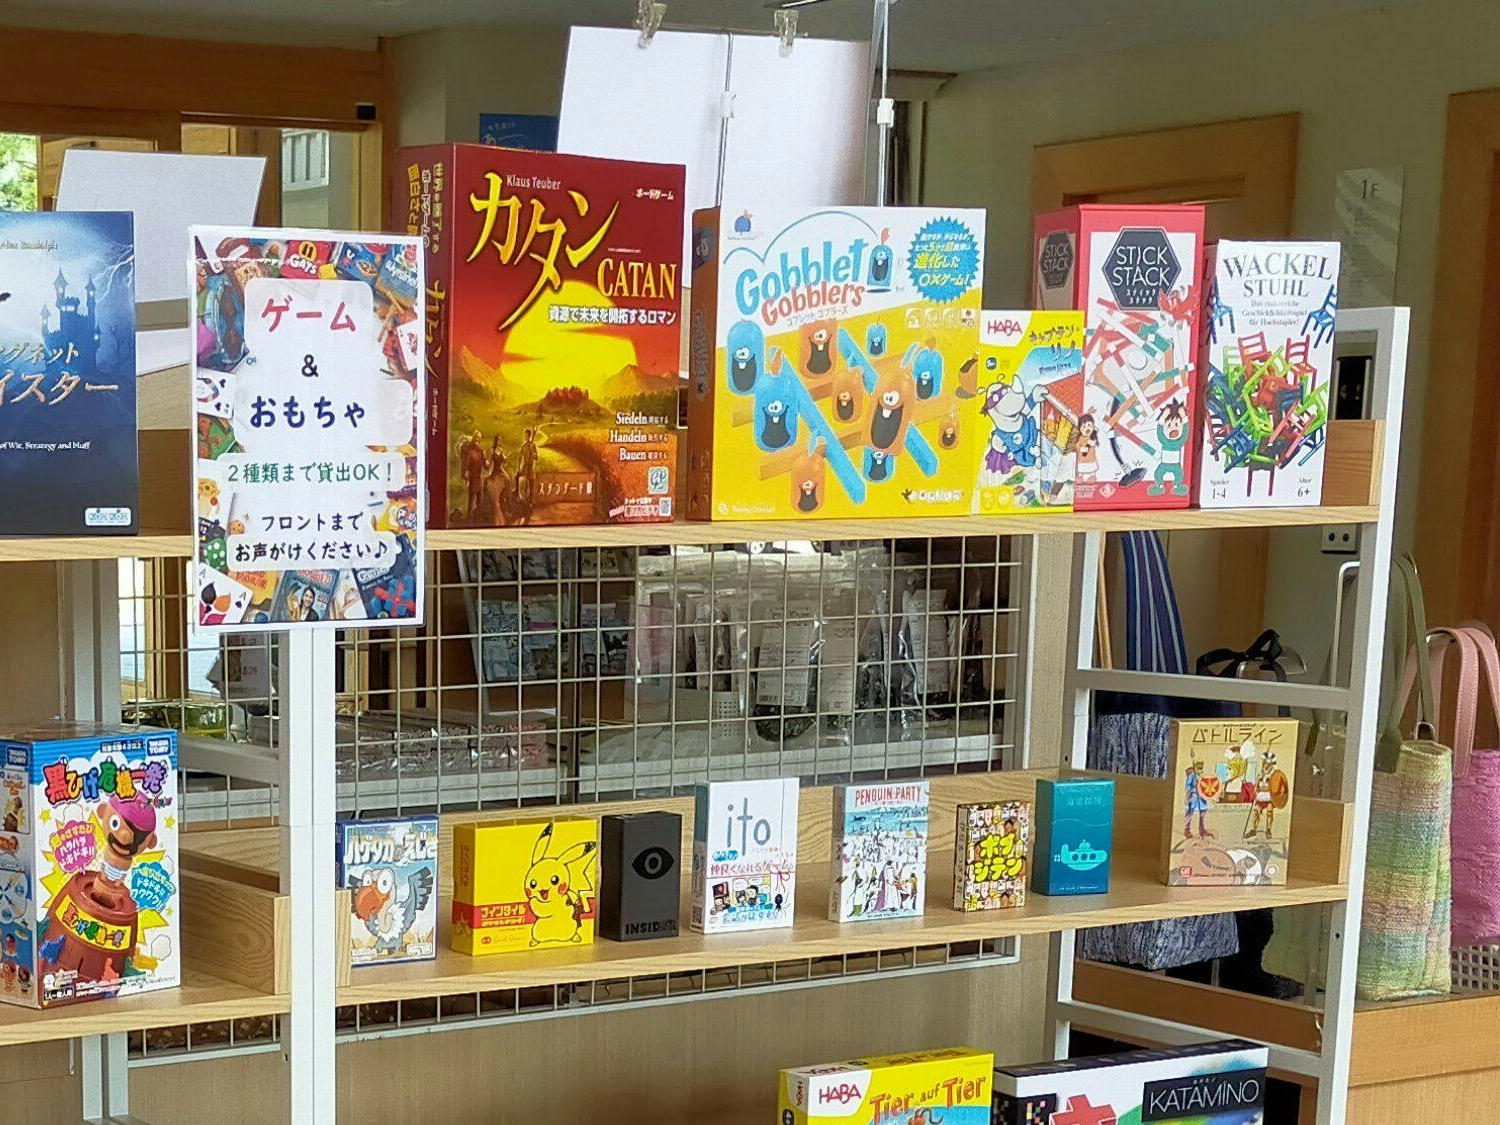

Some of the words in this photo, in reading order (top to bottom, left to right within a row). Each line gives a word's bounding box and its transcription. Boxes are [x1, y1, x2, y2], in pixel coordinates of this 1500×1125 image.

[506, 175, 529, 188] Klaus
[531, 176, 561, 190] Teuber
[465, 172, 620, 332] カタン
[1115, 245, 1168, 266] STICK
[735, 237, 870, 316] Gobblet
[1112, 266, 1171, 288] STACK
[1223, 252, 1335, 281] WACKEL
[597, 258, 676, 300] CATAN
[1243, 278, 1309, 298] STUHL
[261, 295, 356, 332] ゲーム
[548, 304, 676, 325] 資源で未来を開拓するロマン
[761, 281, 866, 327] Gobblers
[986, 319, 1023, 336] HABA
[301, 354, 319, 377] &
[250, 395, 366, 428] おもちゃ
[615, 411, 648, 425] Siedeln
[609, 429, 647, 443] Handeln
[619, 447, 647, 461] Bauen
[1297, 486, 1311, 497] 6+
[261, 513, 364, 532] フロントまで
[1192, 727, 1283, 744] バトルライン
[43, 761, 167, 806] 黒ひげ危機一発
[855, 789, 892, 807] PENGUIN
[895, 785, 922, 803] PARTY
[726, 797, 771, 857] ito
[818, 1083, 862, 1105] HABA
[919, 1083, 941, 1103] auf
[942, 1076, 987, 1108] Tier
[1150, 1079, 1260, 1115] KATAMINO
